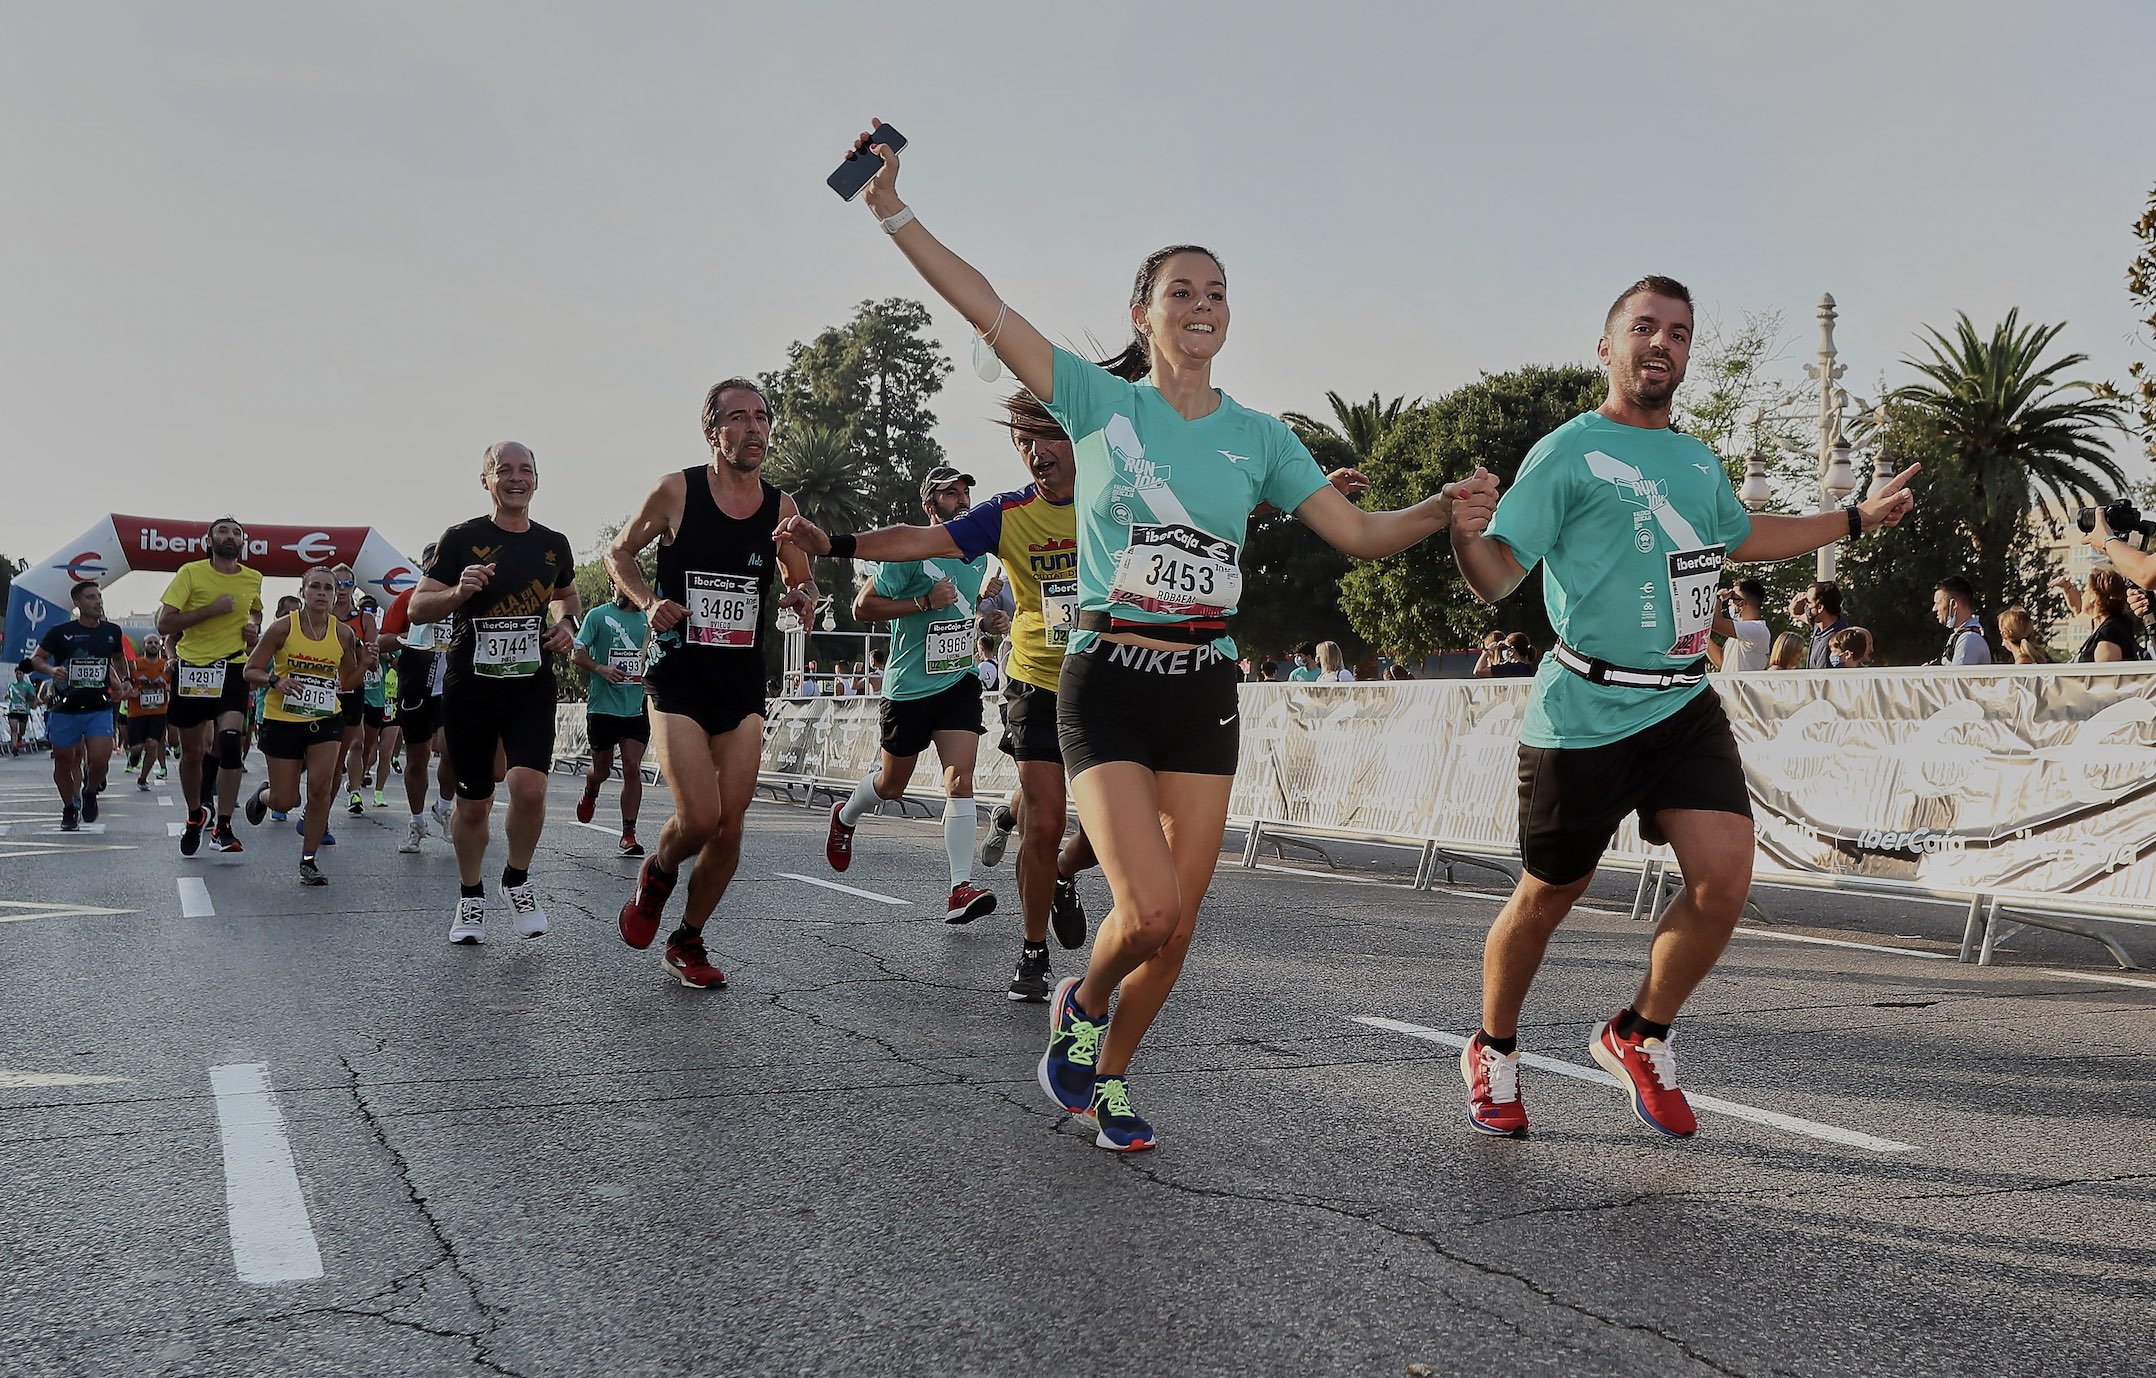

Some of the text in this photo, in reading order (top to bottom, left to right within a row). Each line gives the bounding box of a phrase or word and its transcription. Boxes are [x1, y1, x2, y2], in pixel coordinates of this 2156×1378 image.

[1124, 456, 1156, 476] RUN
[1631, 479, 1659, 497] RUN
[140, 528, 269, 561] iberja
[1144, 528, 1200, 550] iberCaja
[1030, 552, 1078, 572] runn
[1676, 552, 1722, 572] iberCaja
[693, 576, 736, 591] iberCaja
[1032, 570, 1078, 581] CIUTAT D
[1145, 554, 1214, 595] 3453
[700, 597, 745, 621] 3486
[482, 620, 519, 631] iberCaja
[1053, 629, 1066, 641] 02
[488, 637, 528, 657] 3744
[938, 636, 966, 653] 3966
[287, 659, 335, 672] runners
[1108, 643, 1190, 675] NIKE
[189, 671, 215, 684] 4291
[1857, 826, 1966, 854] iberCaja
